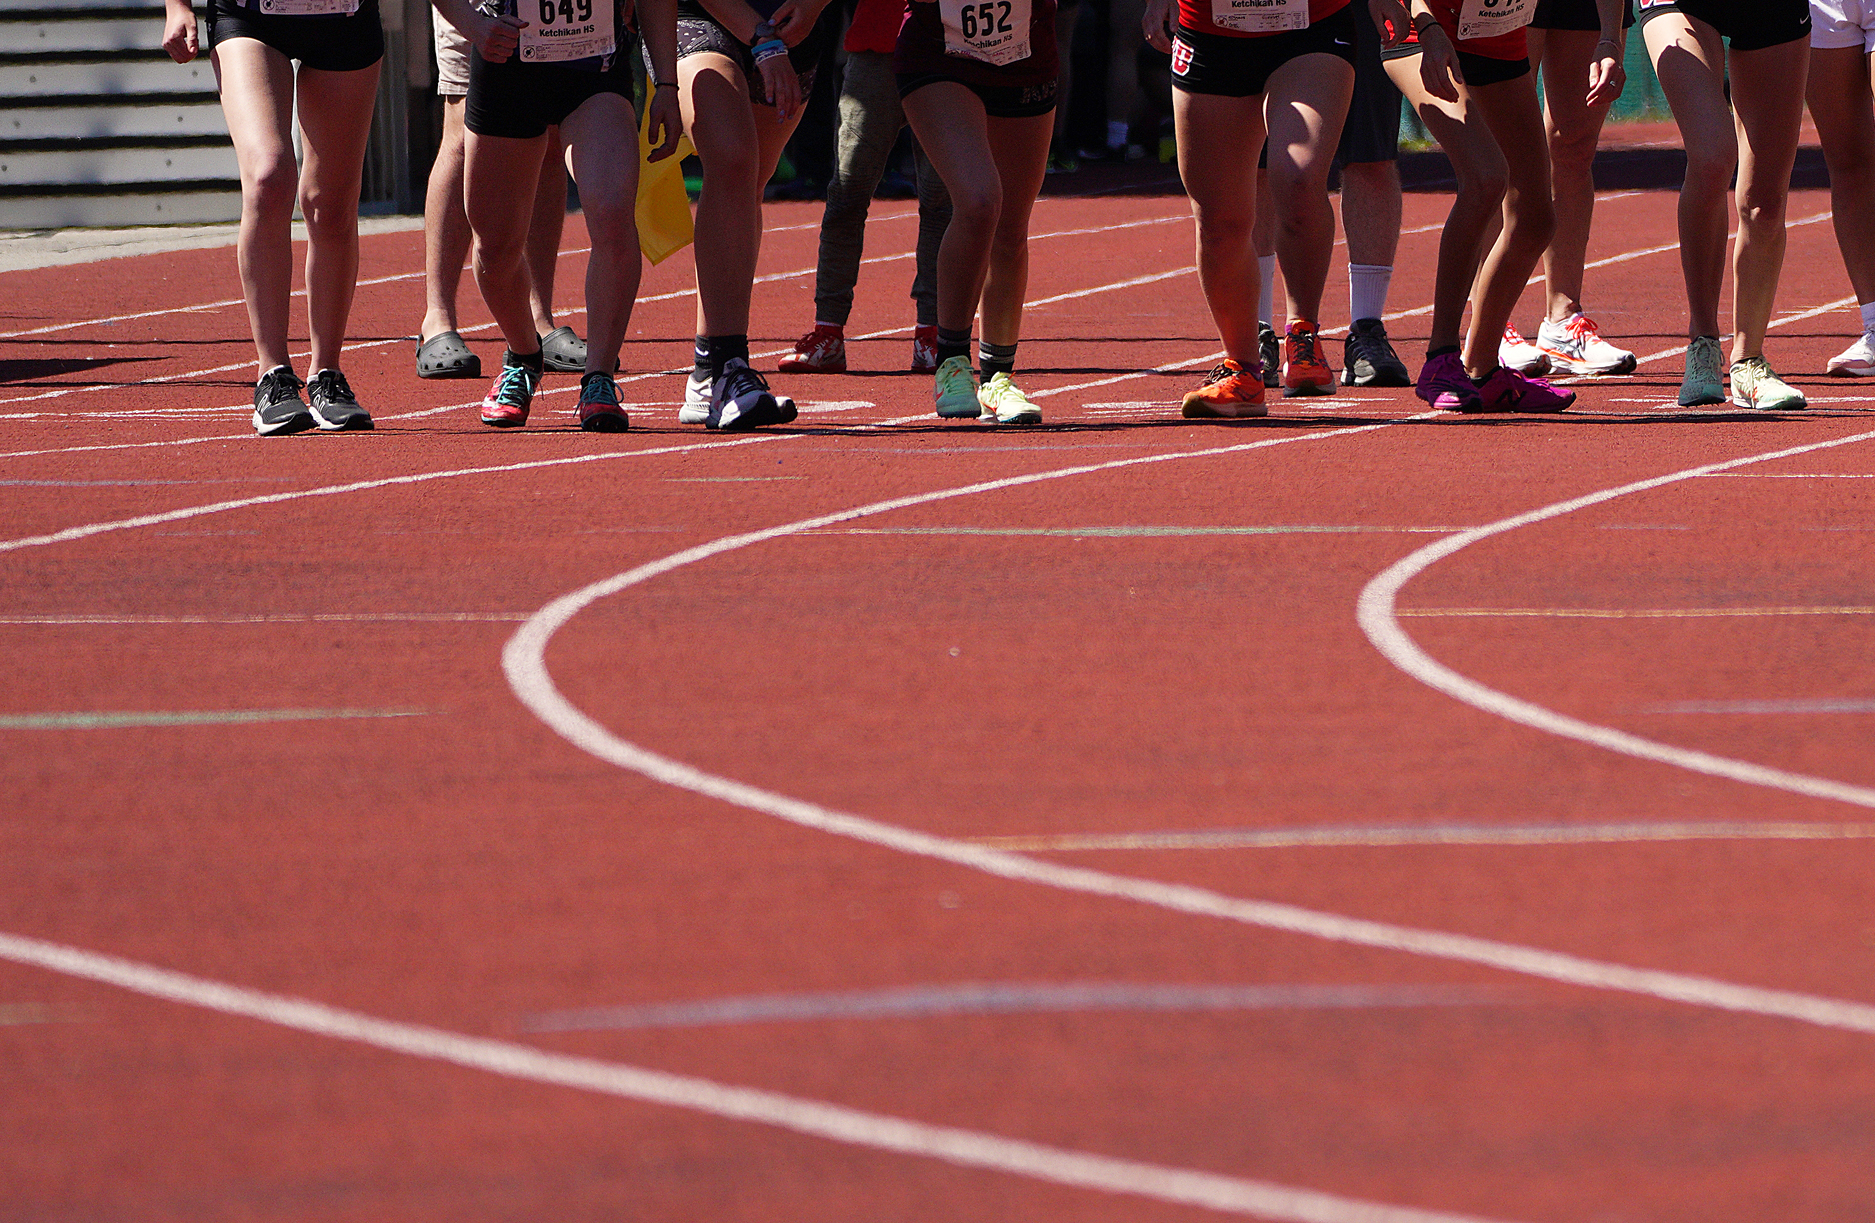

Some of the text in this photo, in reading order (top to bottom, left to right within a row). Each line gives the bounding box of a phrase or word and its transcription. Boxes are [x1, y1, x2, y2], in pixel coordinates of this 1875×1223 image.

[1232, 0, 1274, 8] Ketchikan
[961, 1, 1012, 39] 652
[538, 25, 595, 37] Ketchikan HS
